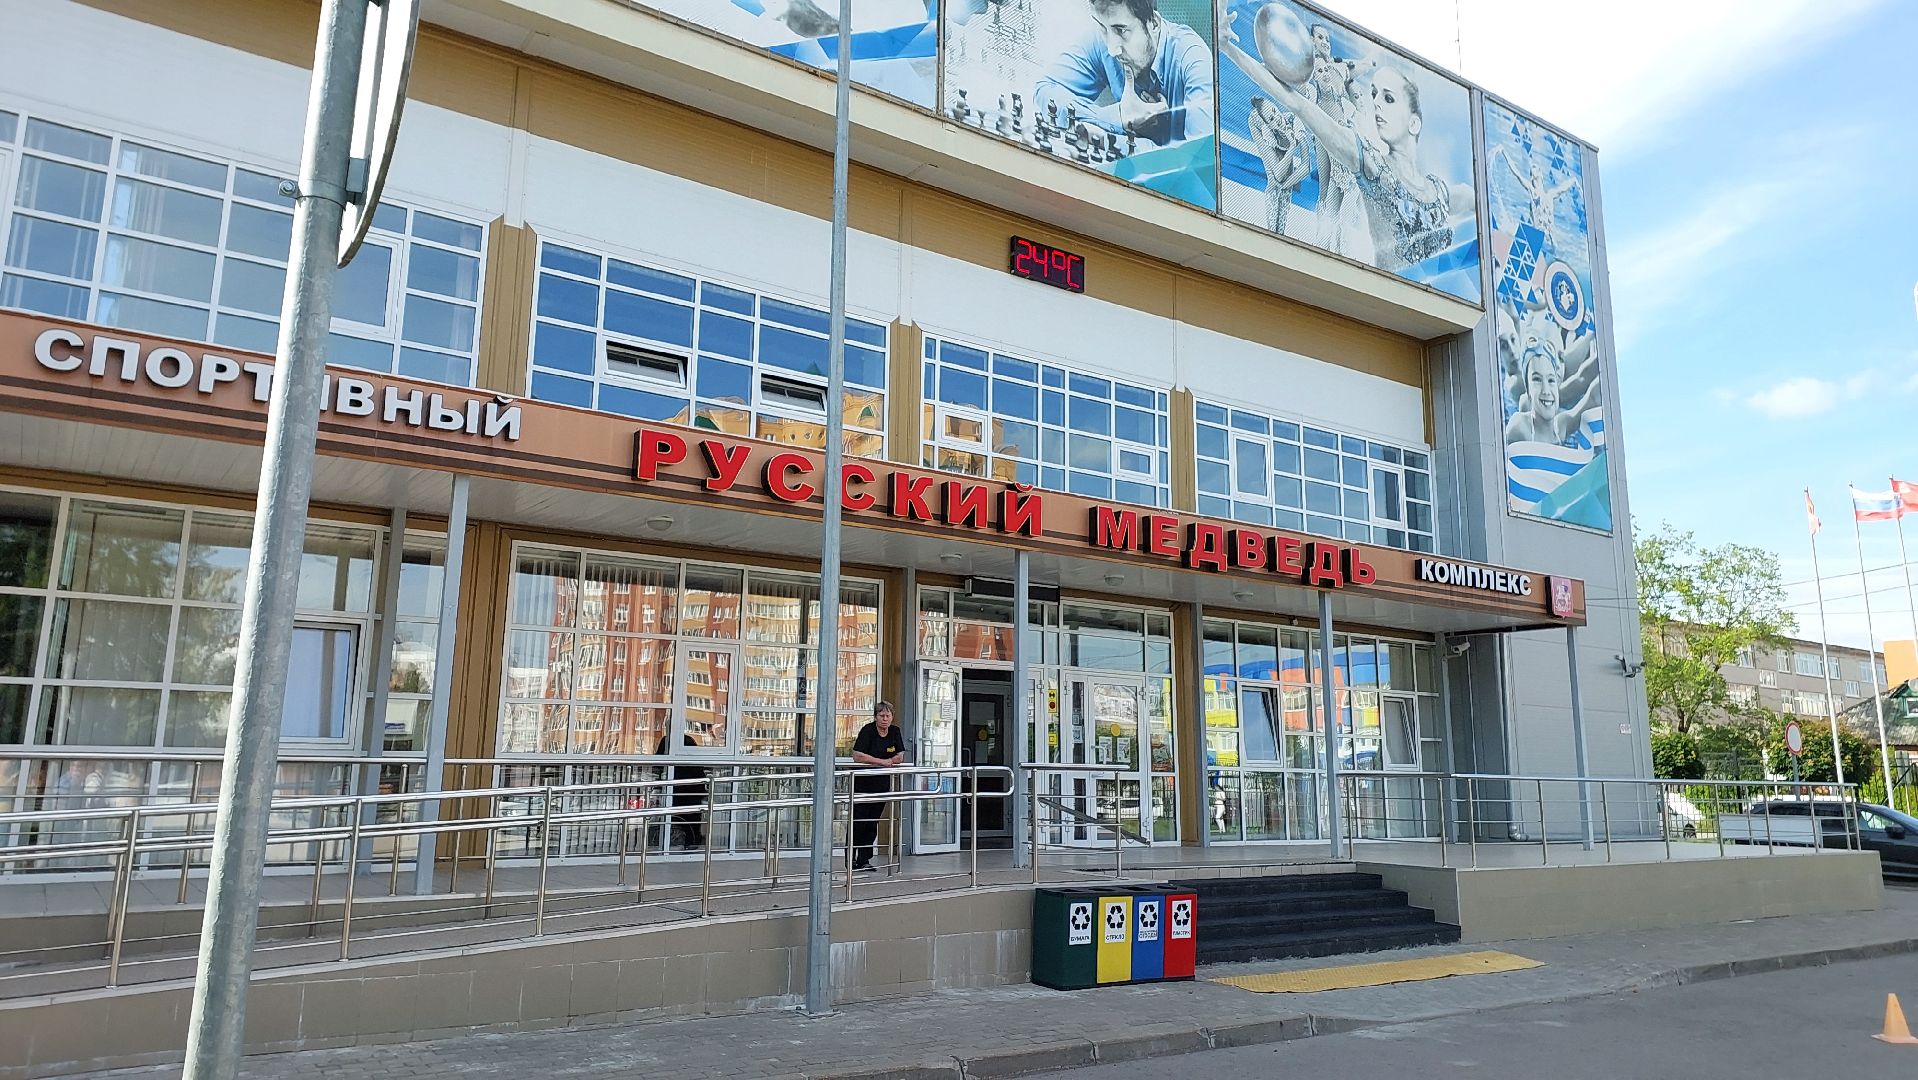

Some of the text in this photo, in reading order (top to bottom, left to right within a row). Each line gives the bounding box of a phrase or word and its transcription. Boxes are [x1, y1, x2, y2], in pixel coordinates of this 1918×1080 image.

[33, 328, 1533, 597] СПОРТВНЫЙ РУССКИЙ МЕДВЕДЬ КОМПЛЕКС
